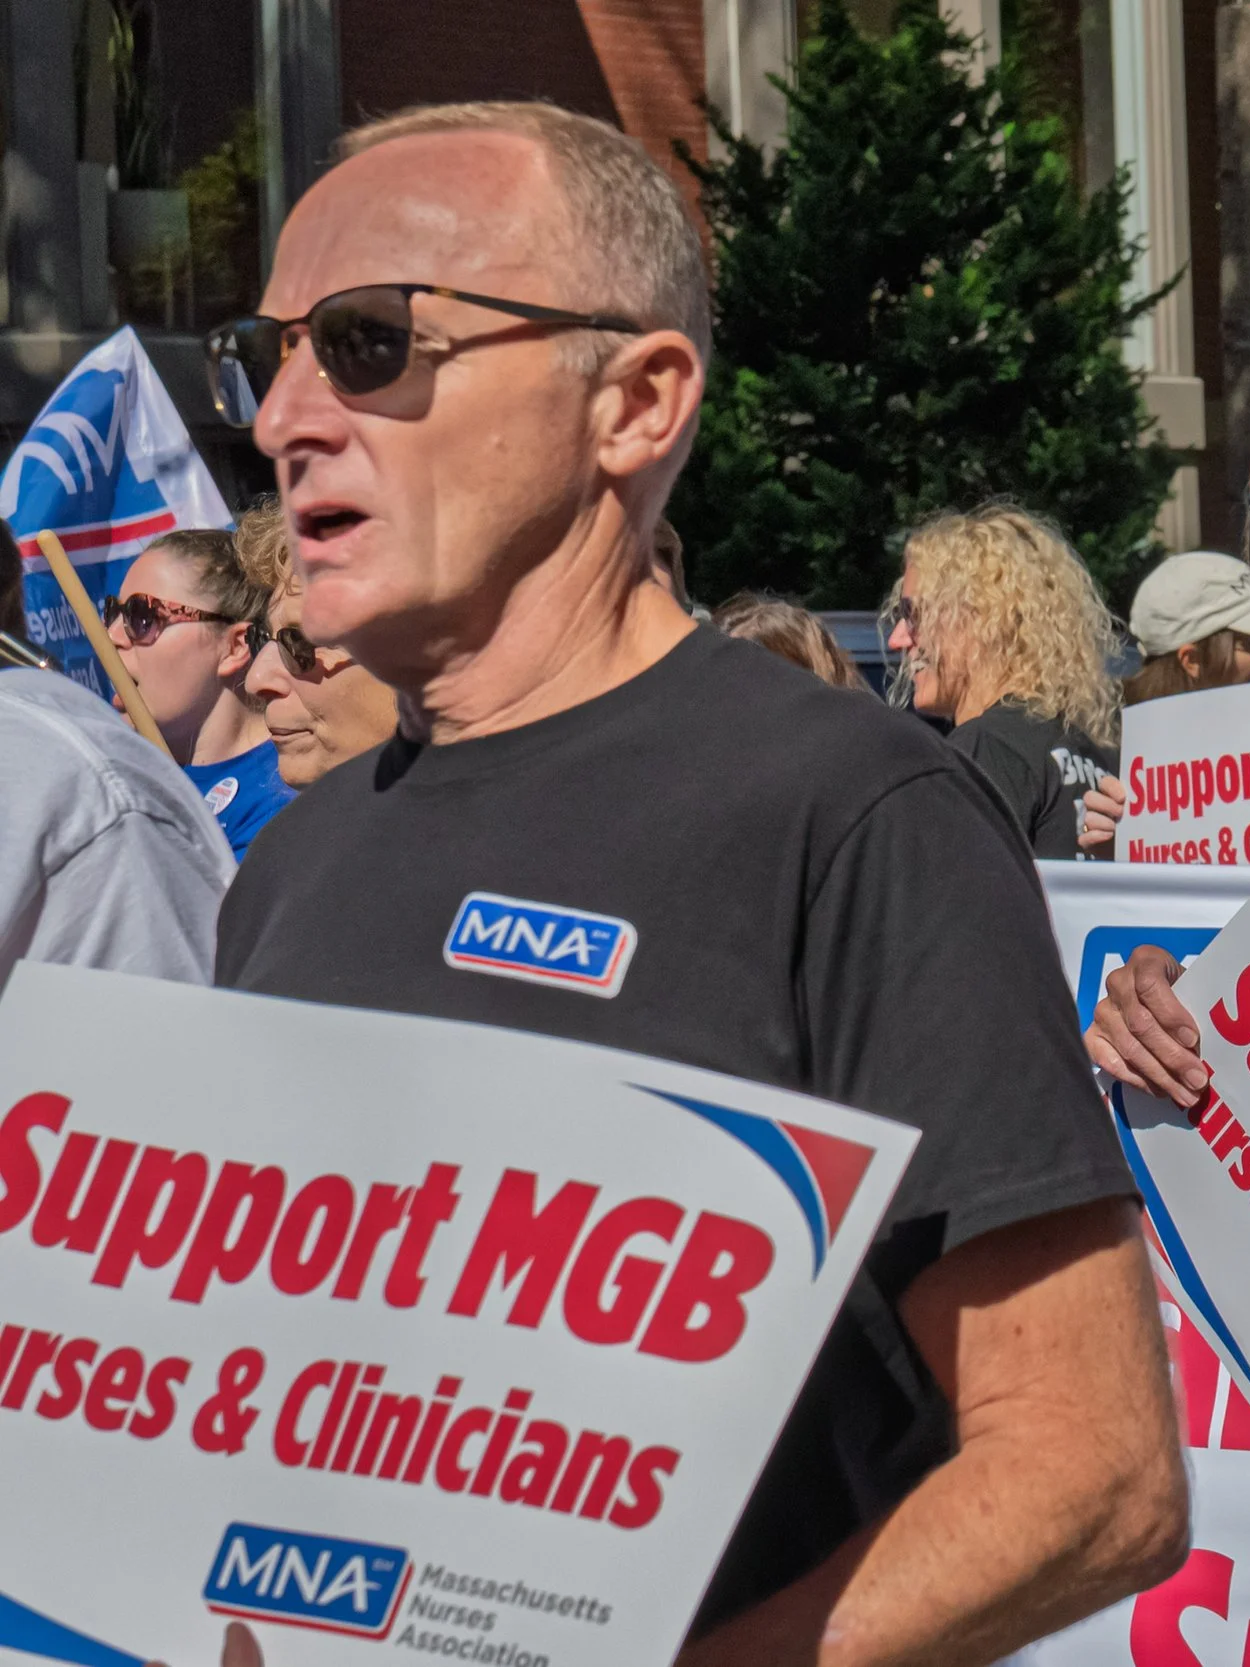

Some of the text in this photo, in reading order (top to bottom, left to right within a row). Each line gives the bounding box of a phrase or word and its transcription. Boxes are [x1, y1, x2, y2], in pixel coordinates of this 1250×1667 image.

[1129, 837, 1212, 865] Nurses
[1218, 827, 1238, 865] &
[458, 908, 599, 966] MNA
[0, 1091, 775, 1363] Support MGB
[0, 1323, 682, 1530] rses & Clinicians
[216, 1536, 382, 1613] MNA
[418, 1562, 613, 1626] Massachusetts
[408, 1594, 498, 1632] Nurses
[395, 1624, 551, 1667] Association
